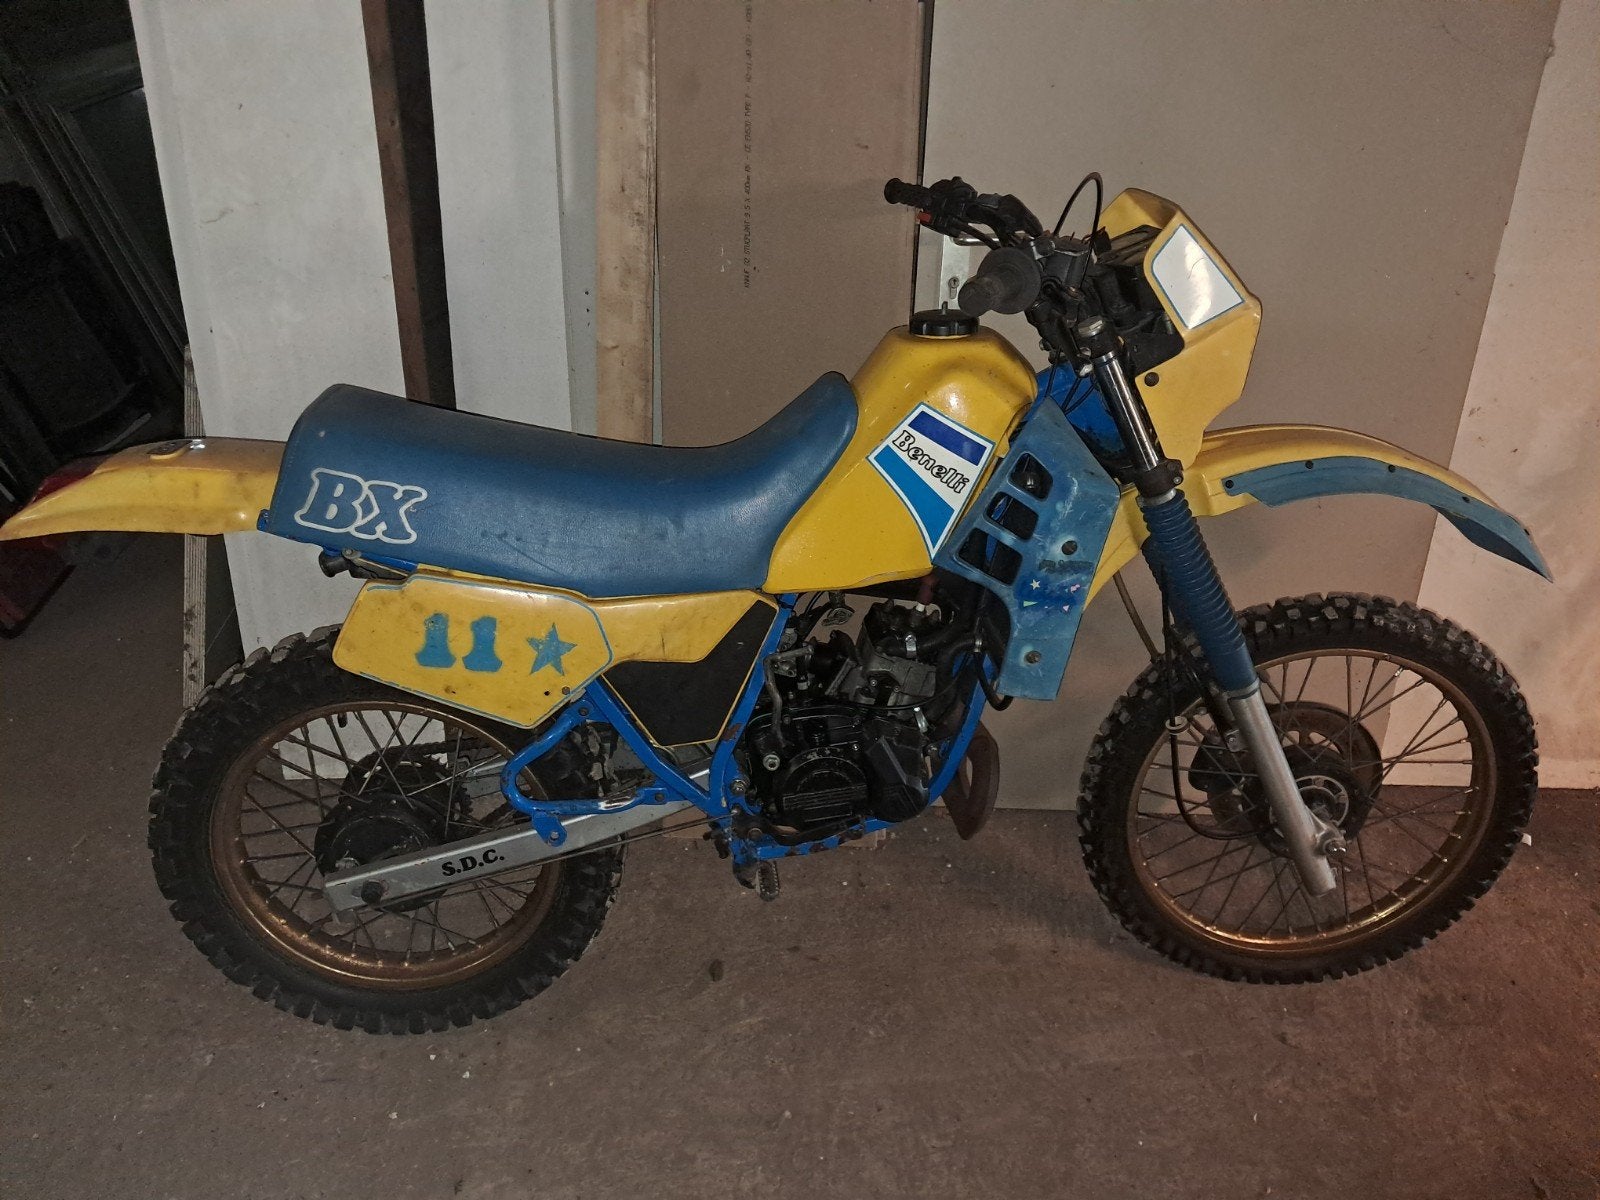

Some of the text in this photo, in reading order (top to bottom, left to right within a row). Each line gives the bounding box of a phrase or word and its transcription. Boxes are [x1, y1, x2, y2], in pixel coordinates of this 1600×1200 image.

[892, 429, 970, 494] Benelli
[293, 467, 428, 544] BX
[415, 612, 503, 673] 11
[441, 848, 505, 877] S.D.C.
